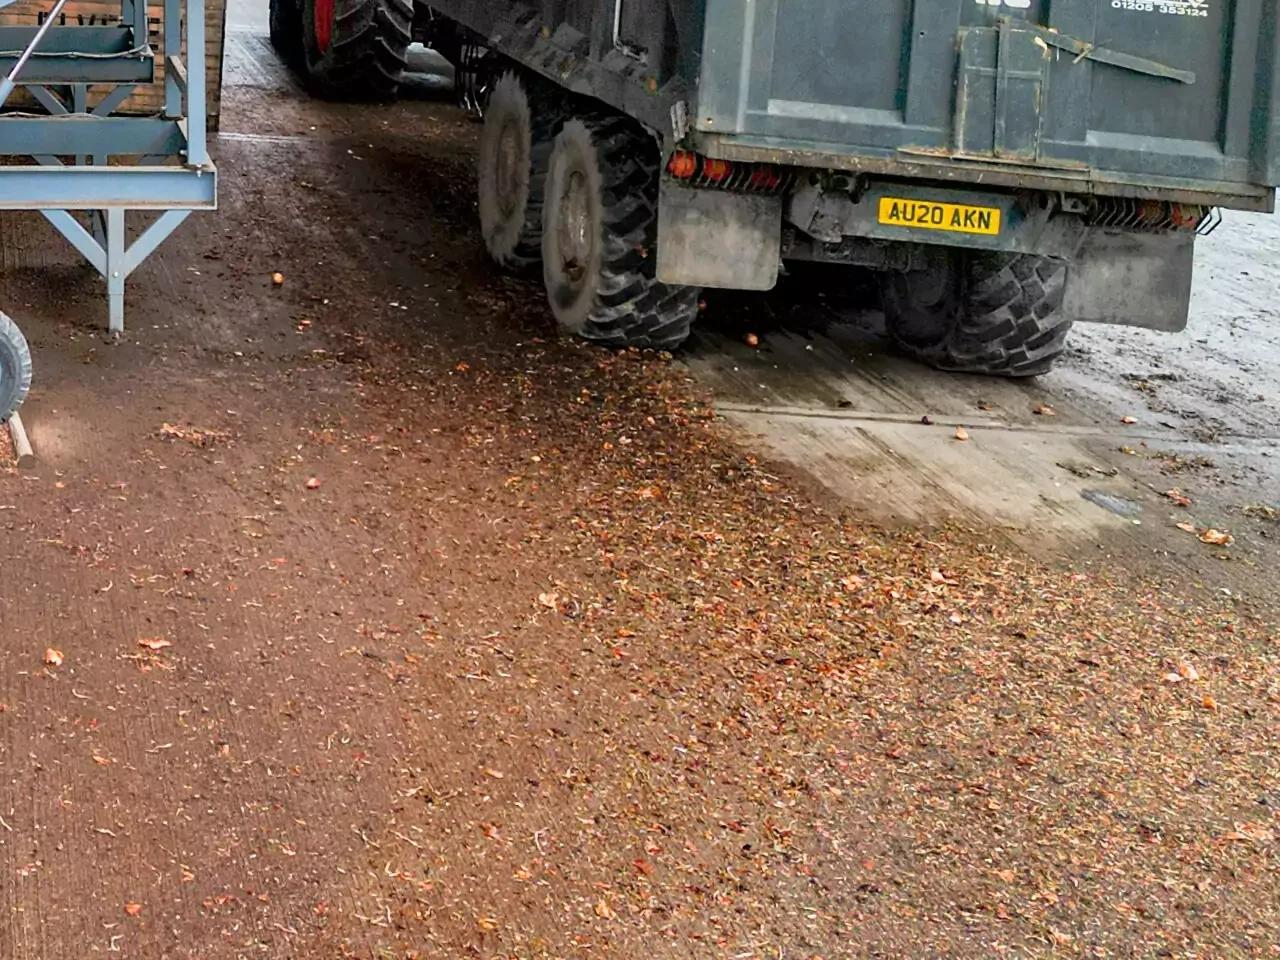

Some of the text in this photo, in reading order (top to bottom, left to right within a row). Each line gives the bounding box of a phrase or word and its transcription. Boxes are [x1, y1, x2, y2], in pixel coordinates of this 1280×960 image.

[1111, 0, 1209, 17] 01205 353124
[888, 201, 991, 230] AU20 AKN
